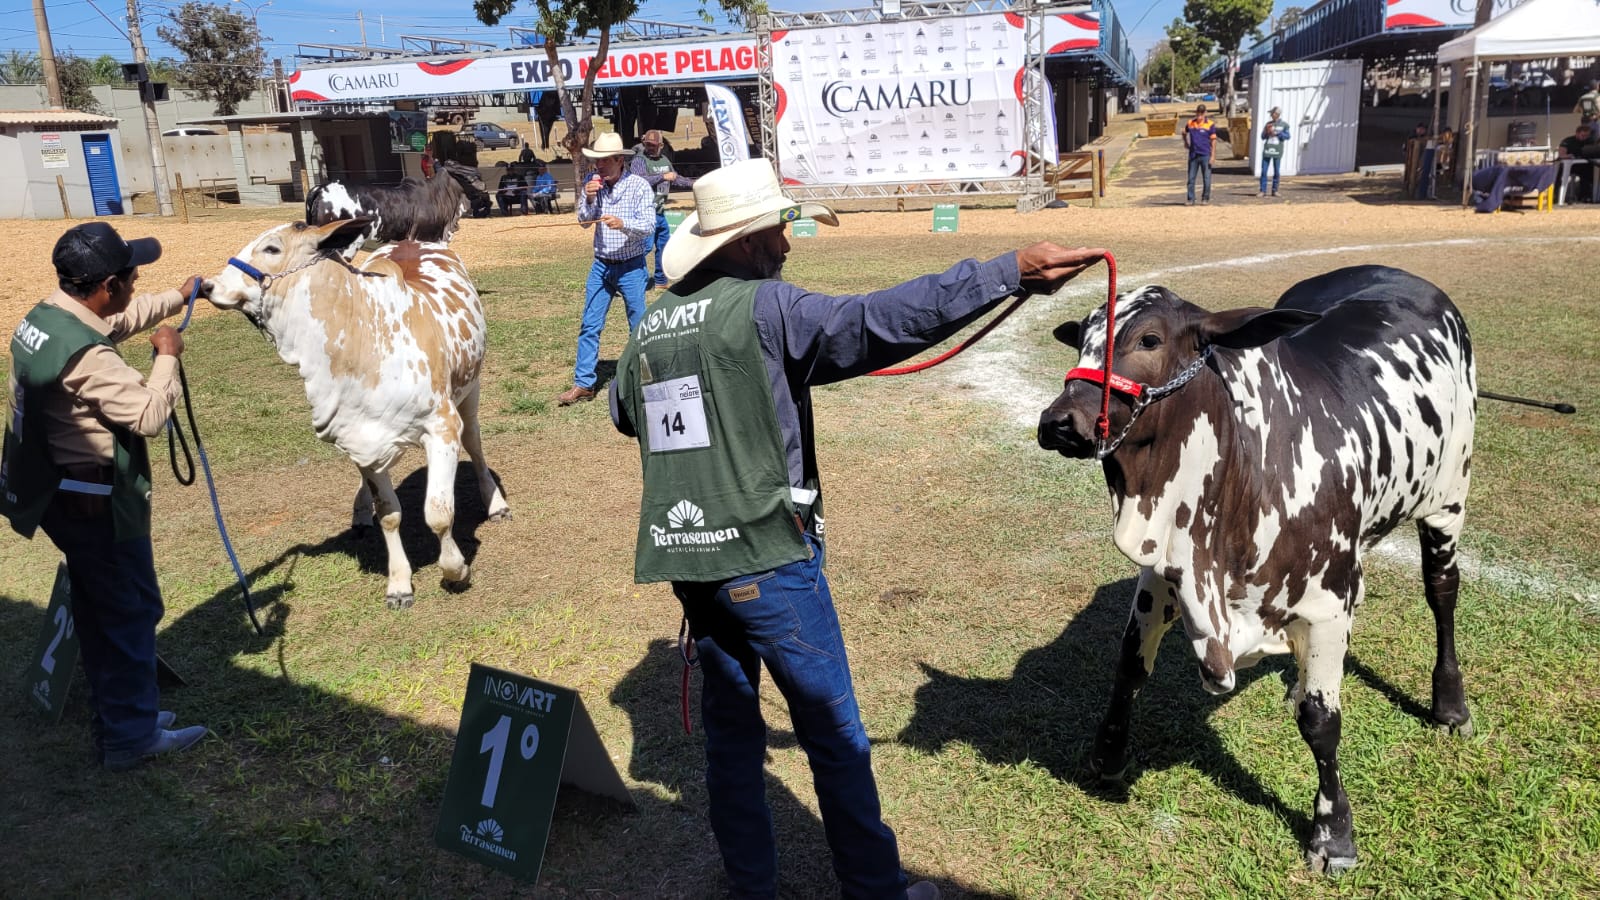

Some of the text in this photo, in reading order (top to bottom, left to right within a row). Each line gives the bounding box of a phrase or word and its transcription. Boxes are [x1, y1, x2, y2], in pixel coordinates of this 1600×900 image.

[330, 72, 399, 92] CAMARU
[511, 58, 572, 83] EXPO
[579, 52, 668, 79] NELORE
[825, 78, 972, 115] CAMARU
[680, 390, 700, 398] nelore
[662, 411, 686, 437] 14
[650, 524, 740, 546] Terrasemen
[484, 675, 557, 713] INOVART
[480, 715, 539, 808] 1º
[460, 824, 518, 861] Terrasemen
